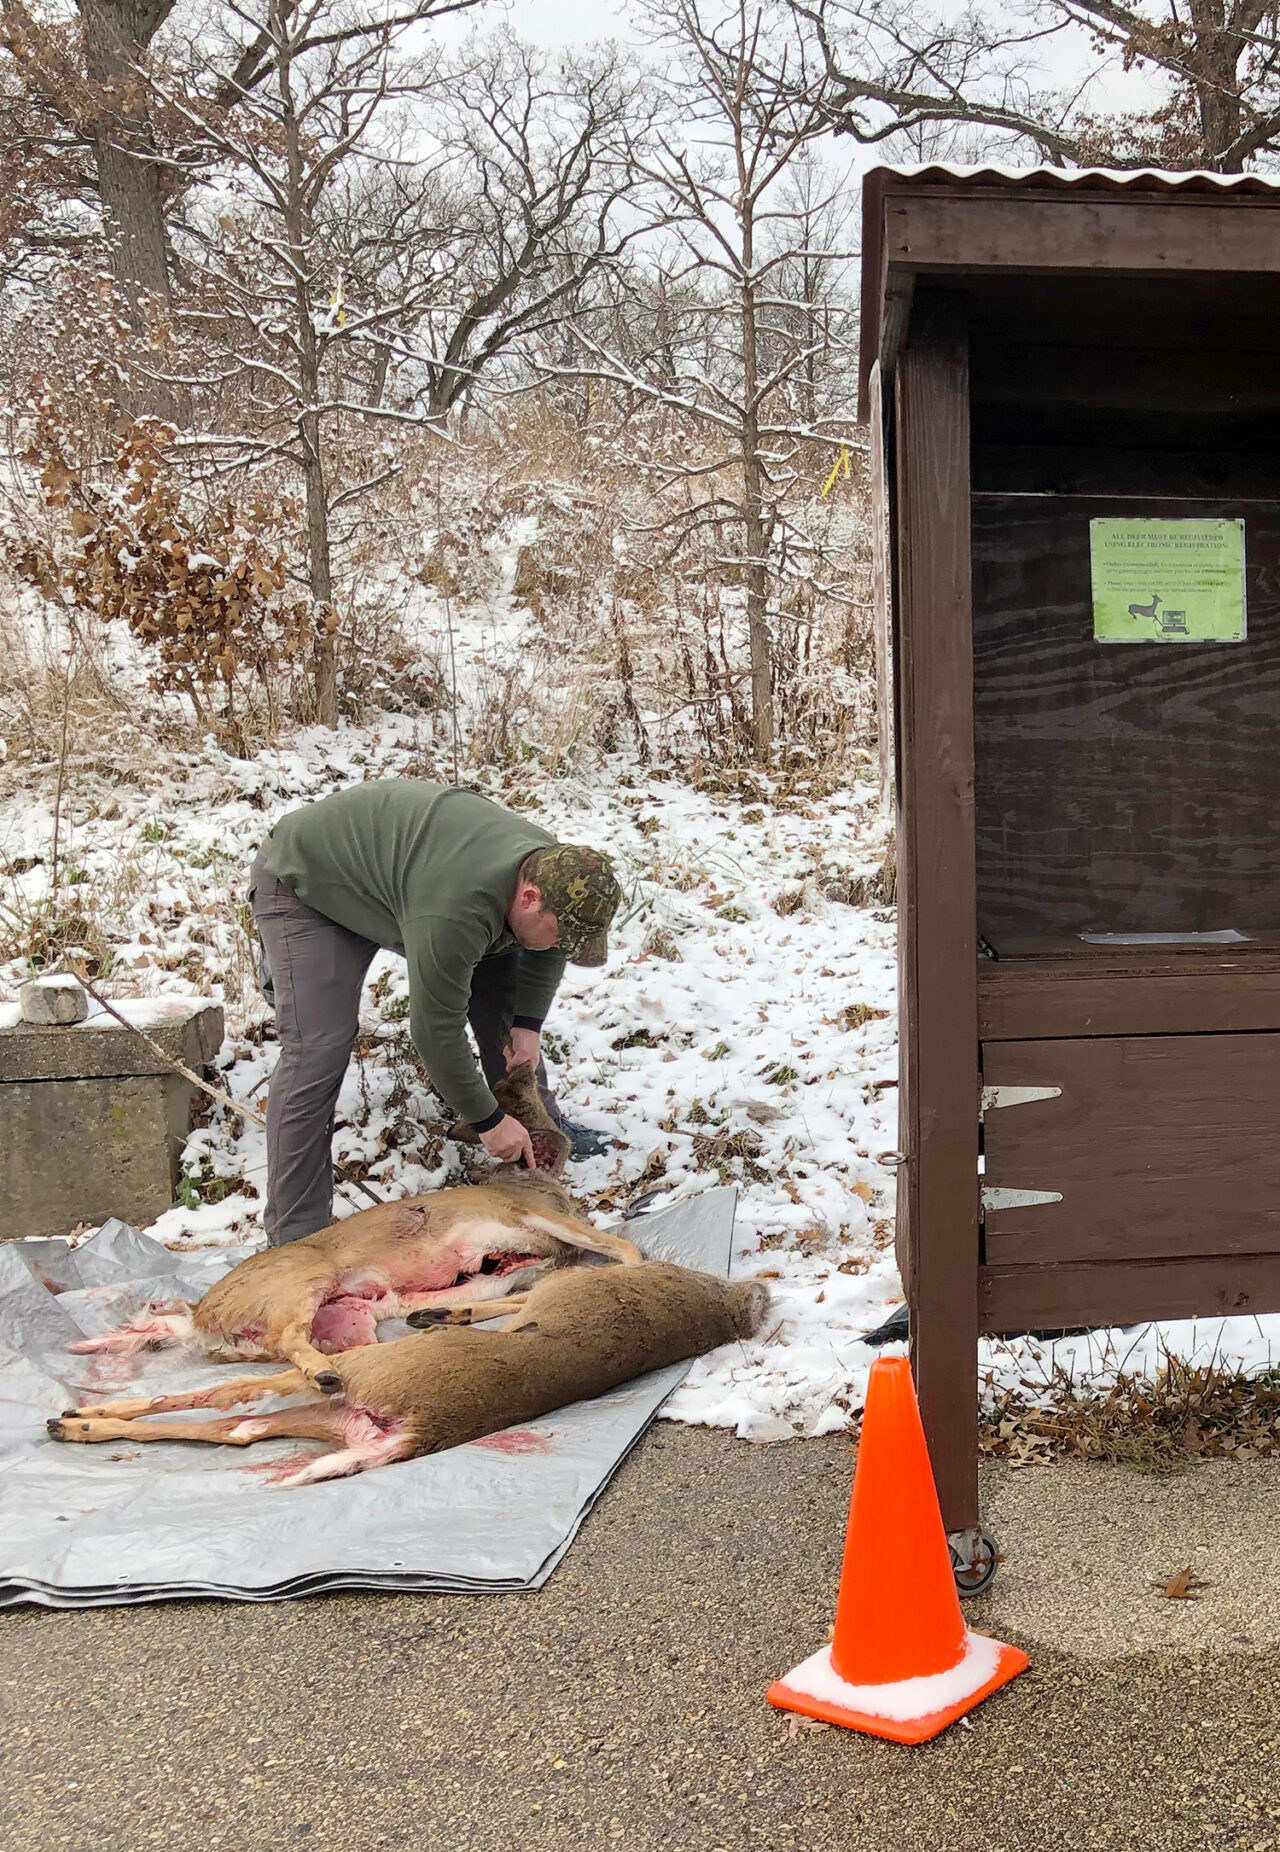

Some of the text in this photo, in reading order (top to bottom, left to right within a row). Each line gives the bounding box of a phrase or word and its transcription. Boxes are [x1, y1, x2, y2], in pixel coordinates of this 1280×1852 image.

[1112, 533, 1126, 541] ALL
[1127, 533, 1146, 541] DEER
[1147, 533, 1168, 541] MUST
[1128, 541, 1173, 549] ELECTRONIC
